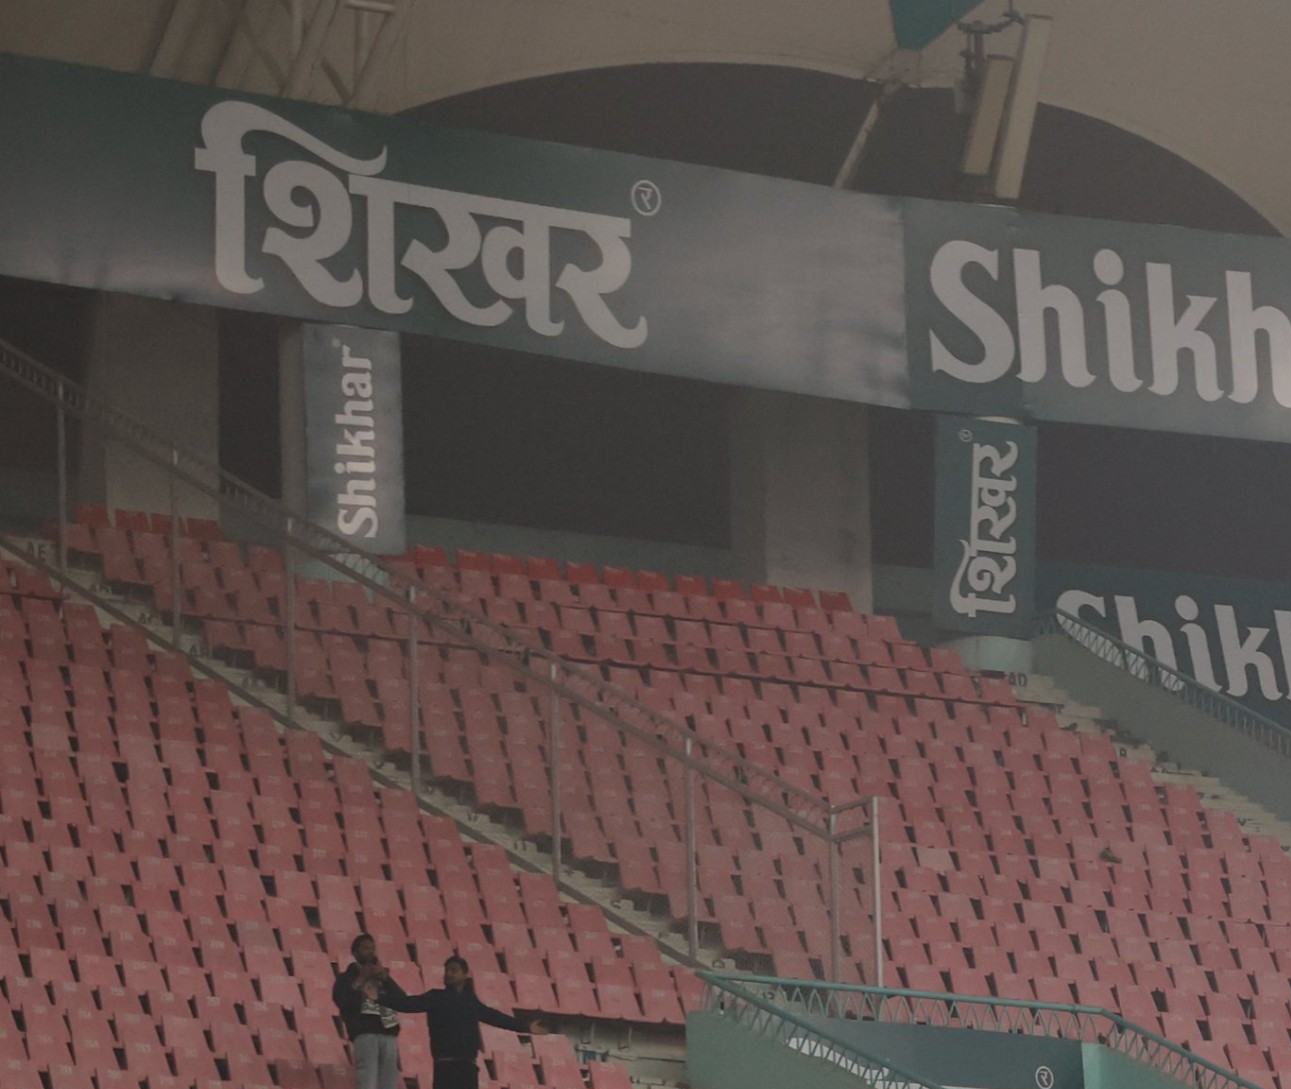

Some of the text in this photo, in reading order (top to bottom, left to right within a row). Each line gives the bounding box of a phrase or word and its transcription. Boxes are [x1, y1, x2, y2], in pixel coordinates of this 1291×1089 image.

[194, 100, 649, 349] शिखर
[336, 343, 380, 539] Shikhar
[950, 440, 1020, 619] शिखर
